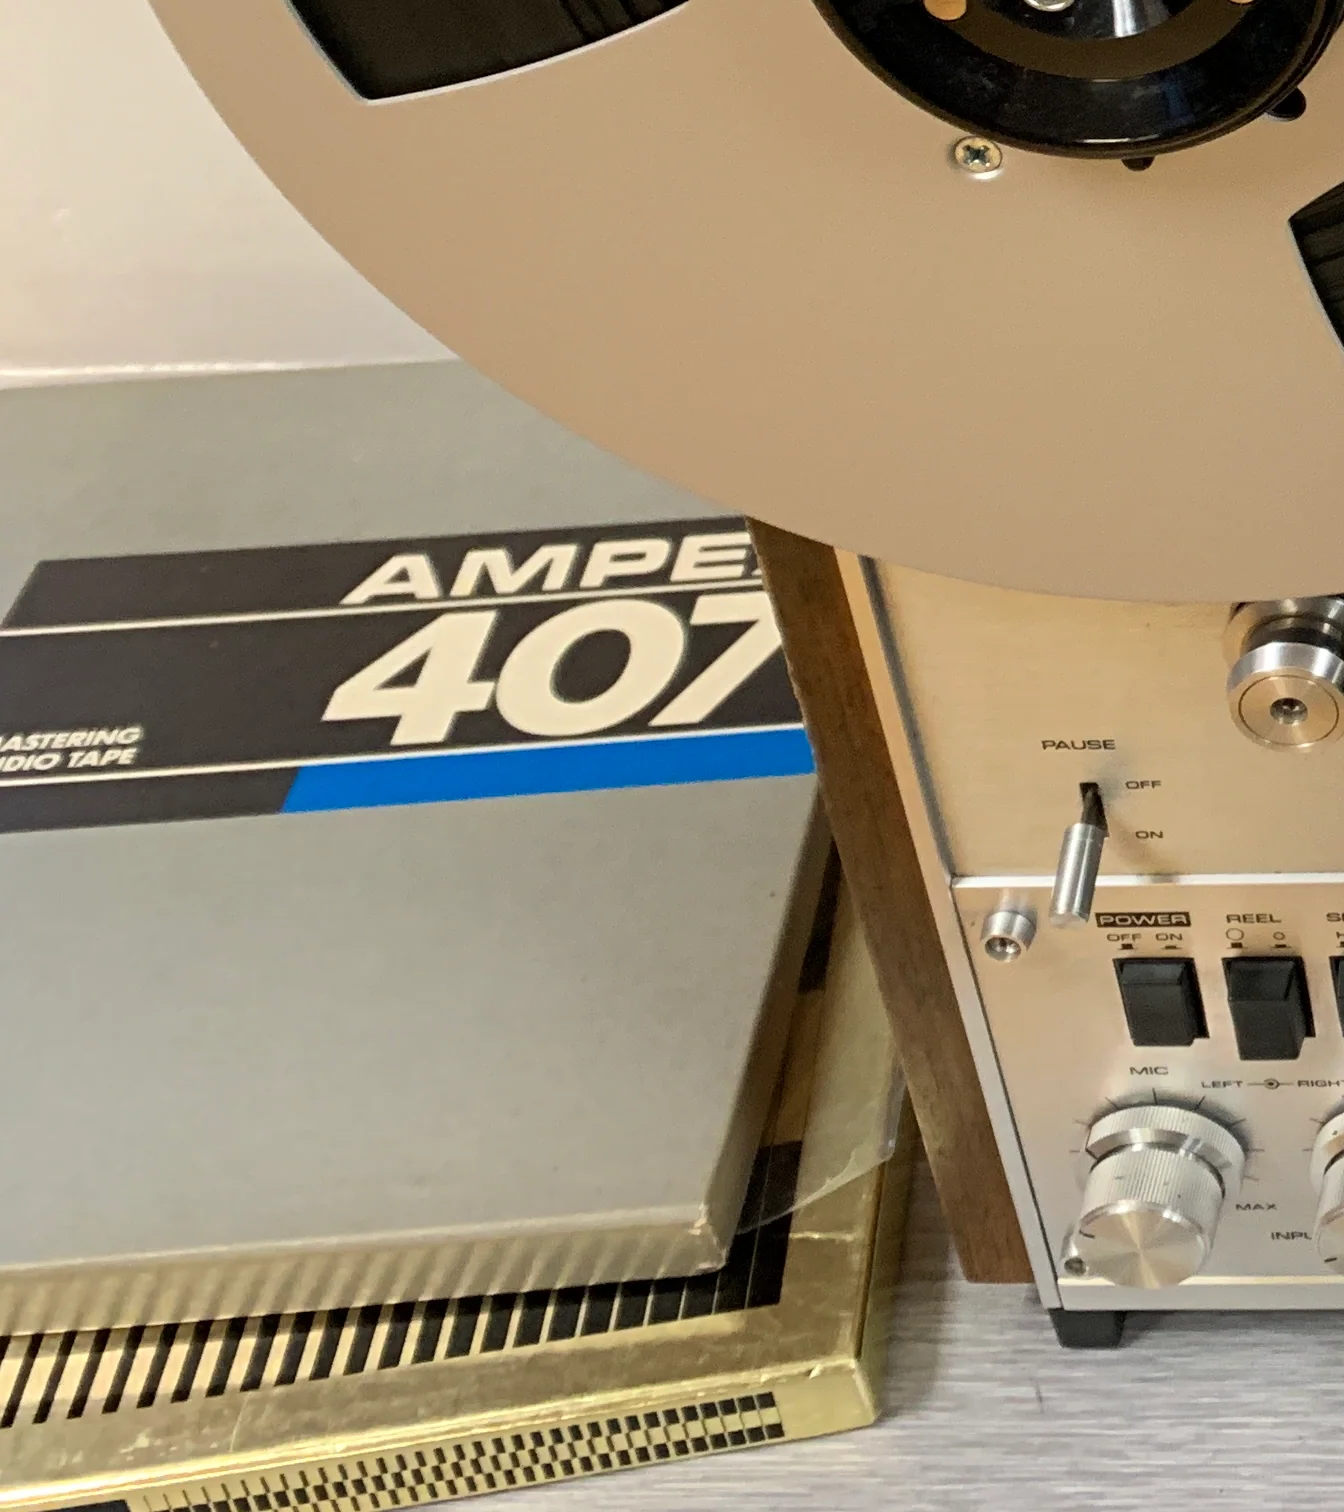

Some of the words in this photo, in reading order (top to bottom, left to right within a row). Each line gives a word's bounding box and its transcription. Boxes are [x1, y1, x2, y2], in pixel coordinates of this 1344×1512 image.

[338, 531, 764, 606] AMPE
[321, 590, 783, 747] 407
[0, 725, 144, 753] ASTERING
[1041, 739, 1117, 751] PAUSE
[67, 747, 138, 769] TAPE
[1125, 780, 1162, 790] OFF
[1135, 830, 1164, 839] ON
[1099, 913, 1188, 926] POWER
[1226, 913, 1283, 924] REEL
[1106, 933, 1142, 943] OFF
[1155, 932, 1183, 942] ON
[1129, 1065, 1169, 1076] MIC
[1200, 1080, 1244, 1089] LEFT
[1235, 1202, 1278, 1211] MAX
